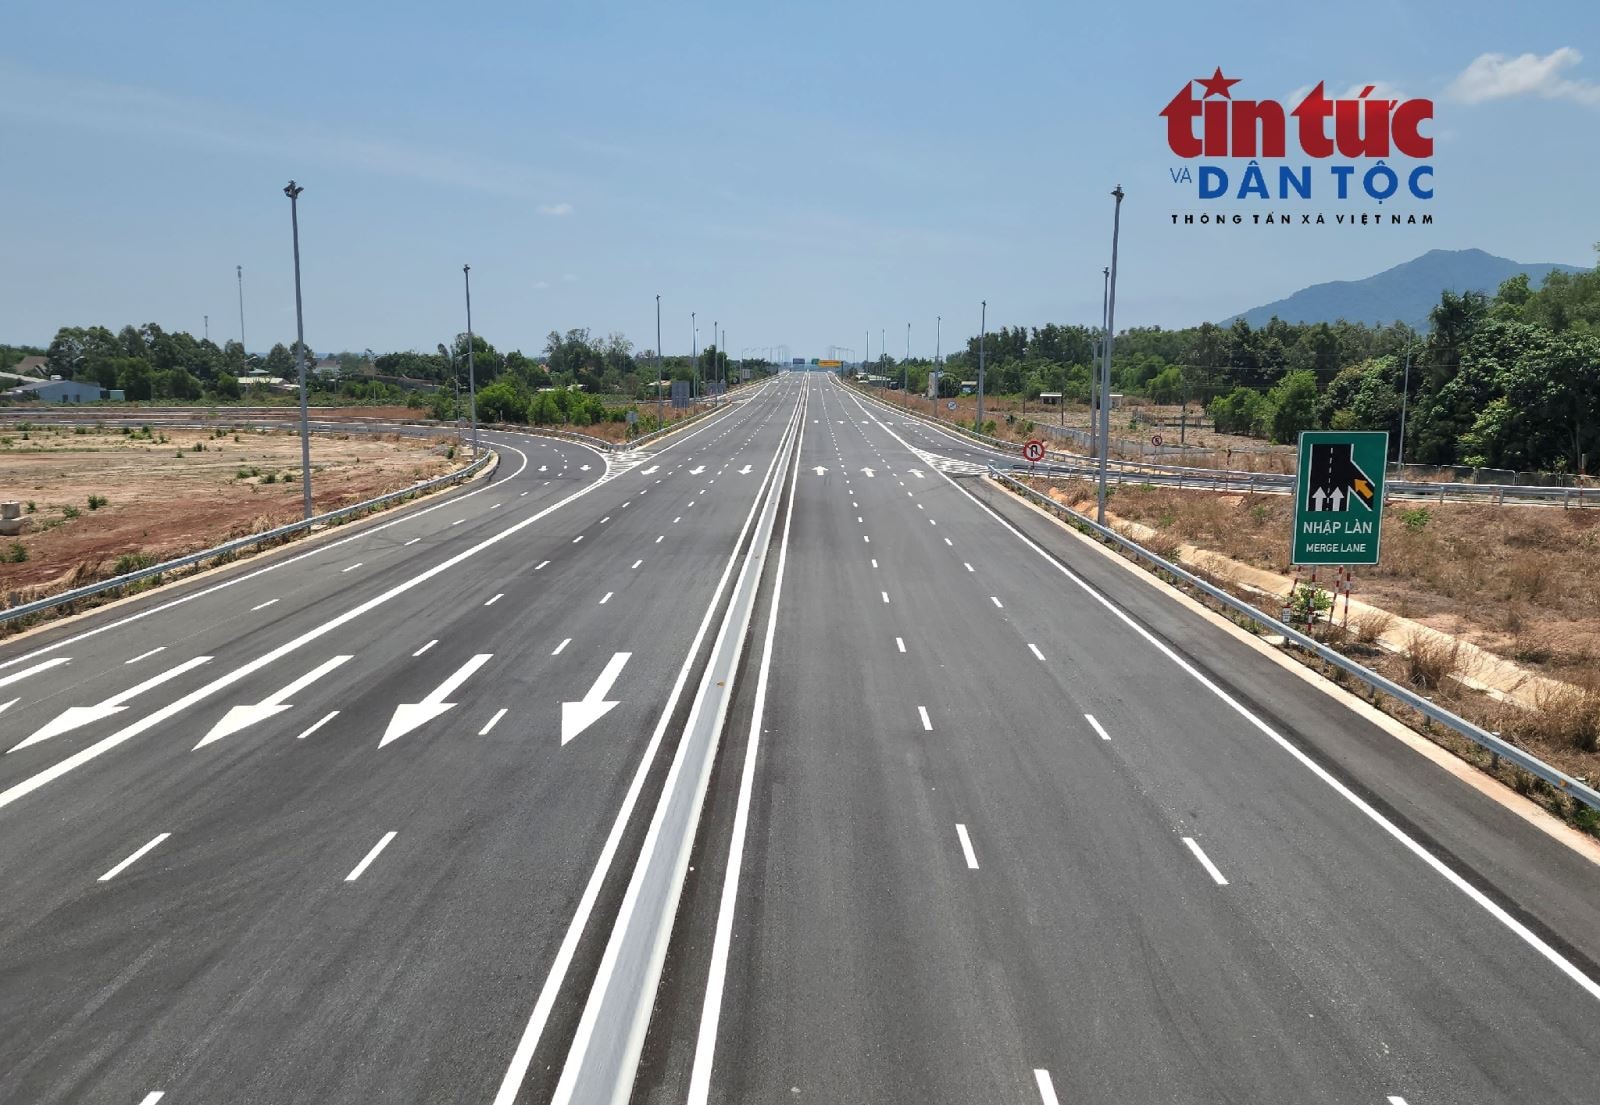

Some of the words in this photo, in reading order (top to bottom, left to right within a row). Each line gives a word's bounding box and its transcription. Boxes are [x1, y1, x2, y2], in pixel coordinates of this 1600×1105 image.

[1303, 519, 1342, 536] NHẬP
[1344, 518, 1373, 534] LÀN
[1305, 543, 1339, 553] MERGE
[1340, 543, 1367, 553] LANE
